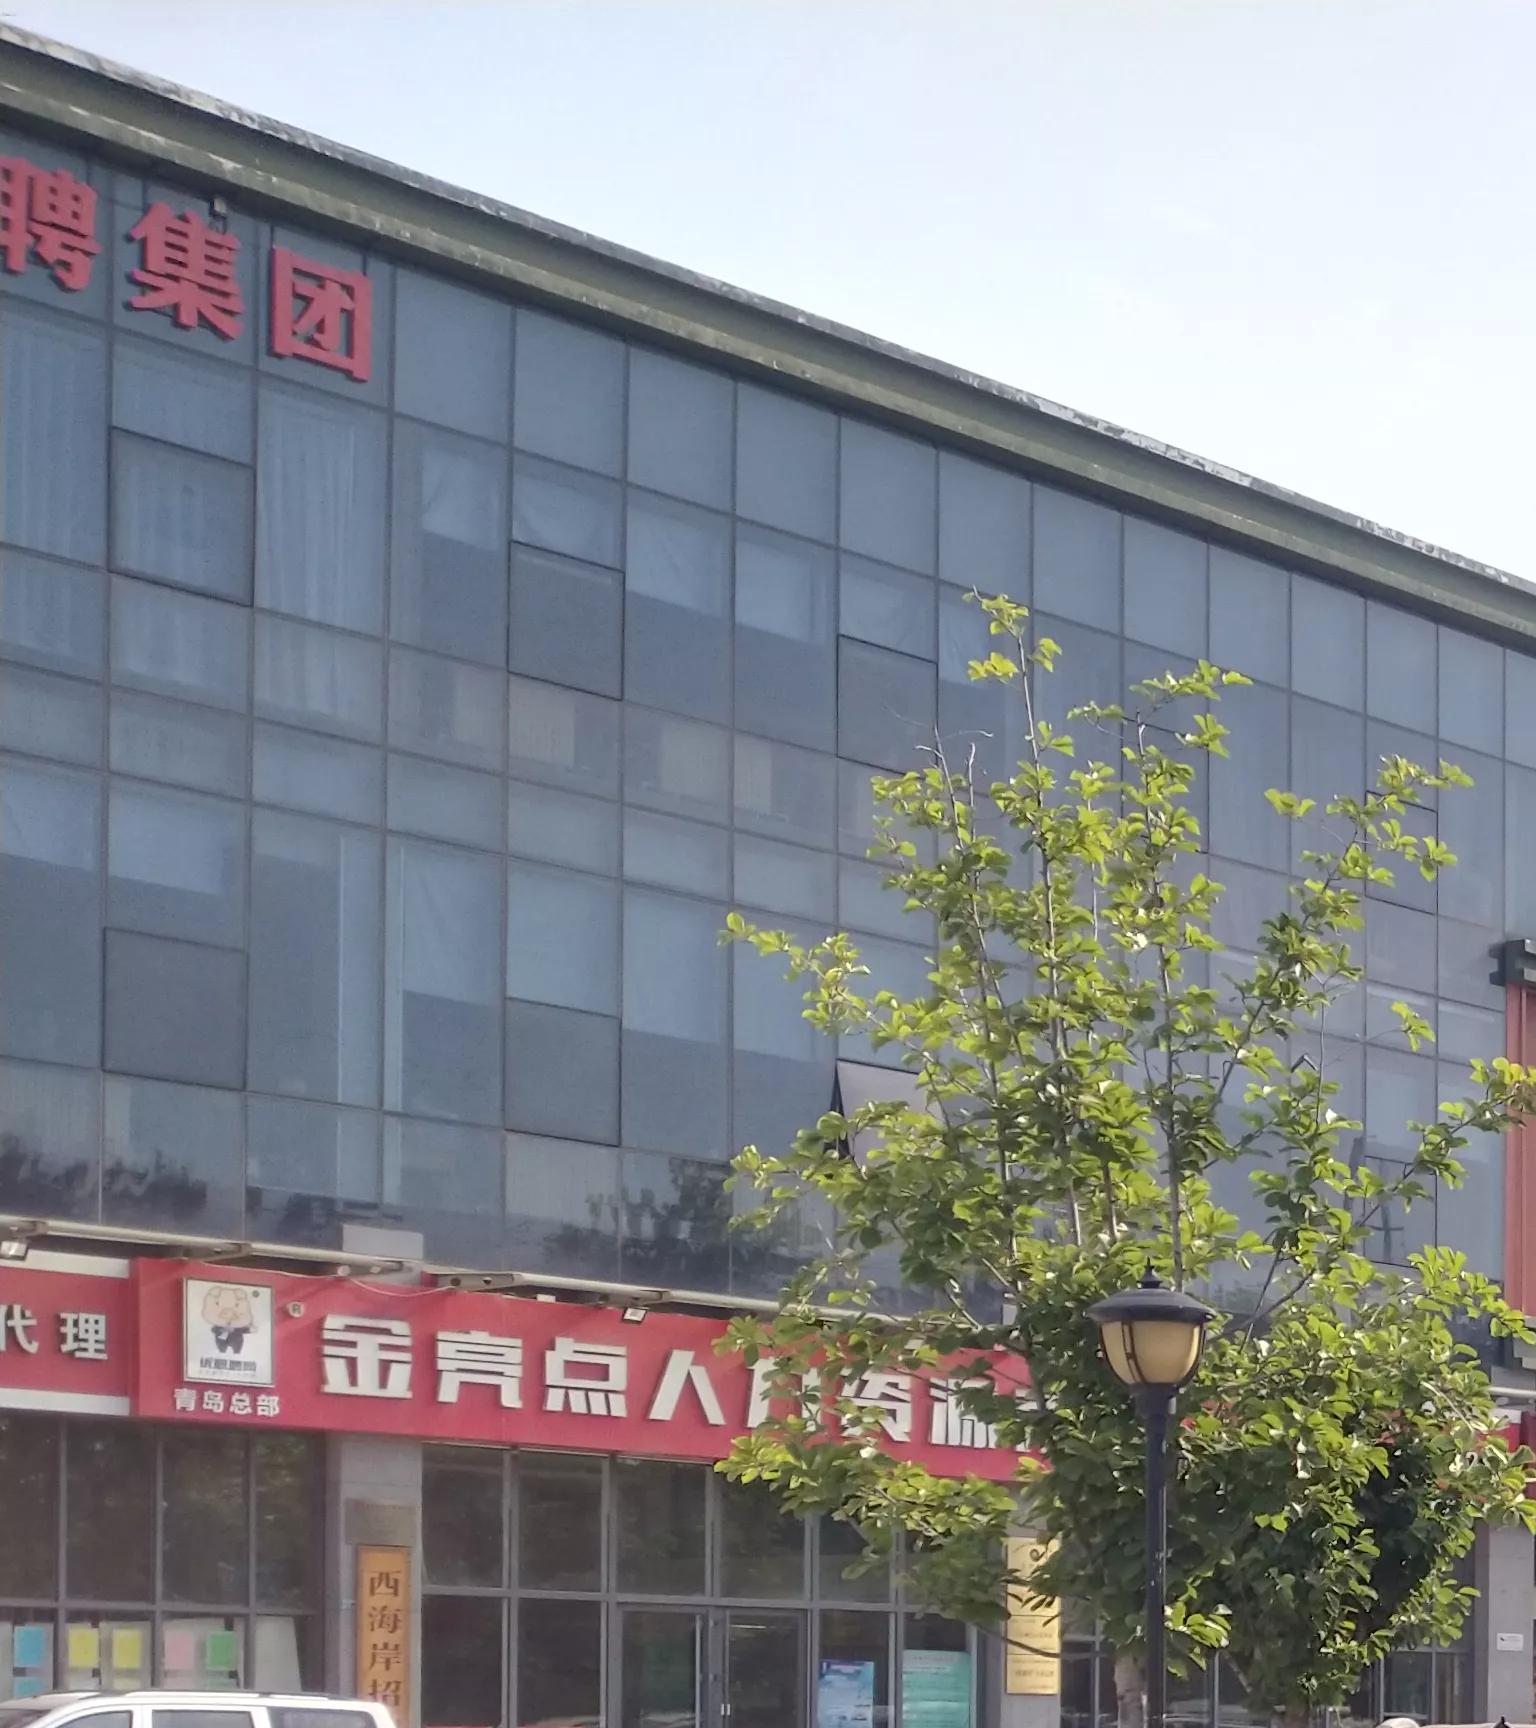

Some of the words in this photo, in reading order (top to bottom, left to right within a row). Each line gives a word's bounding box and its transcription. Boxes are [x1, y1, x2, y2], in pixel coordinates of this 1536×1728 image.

[0, 156, 374, 383] 聘集团
[0, 1304, 108, 1360] 代理
[174, 1388, 280, 1417] 青岛总部
[320, 1312, 1056, 1453] 金亮点人力资源
